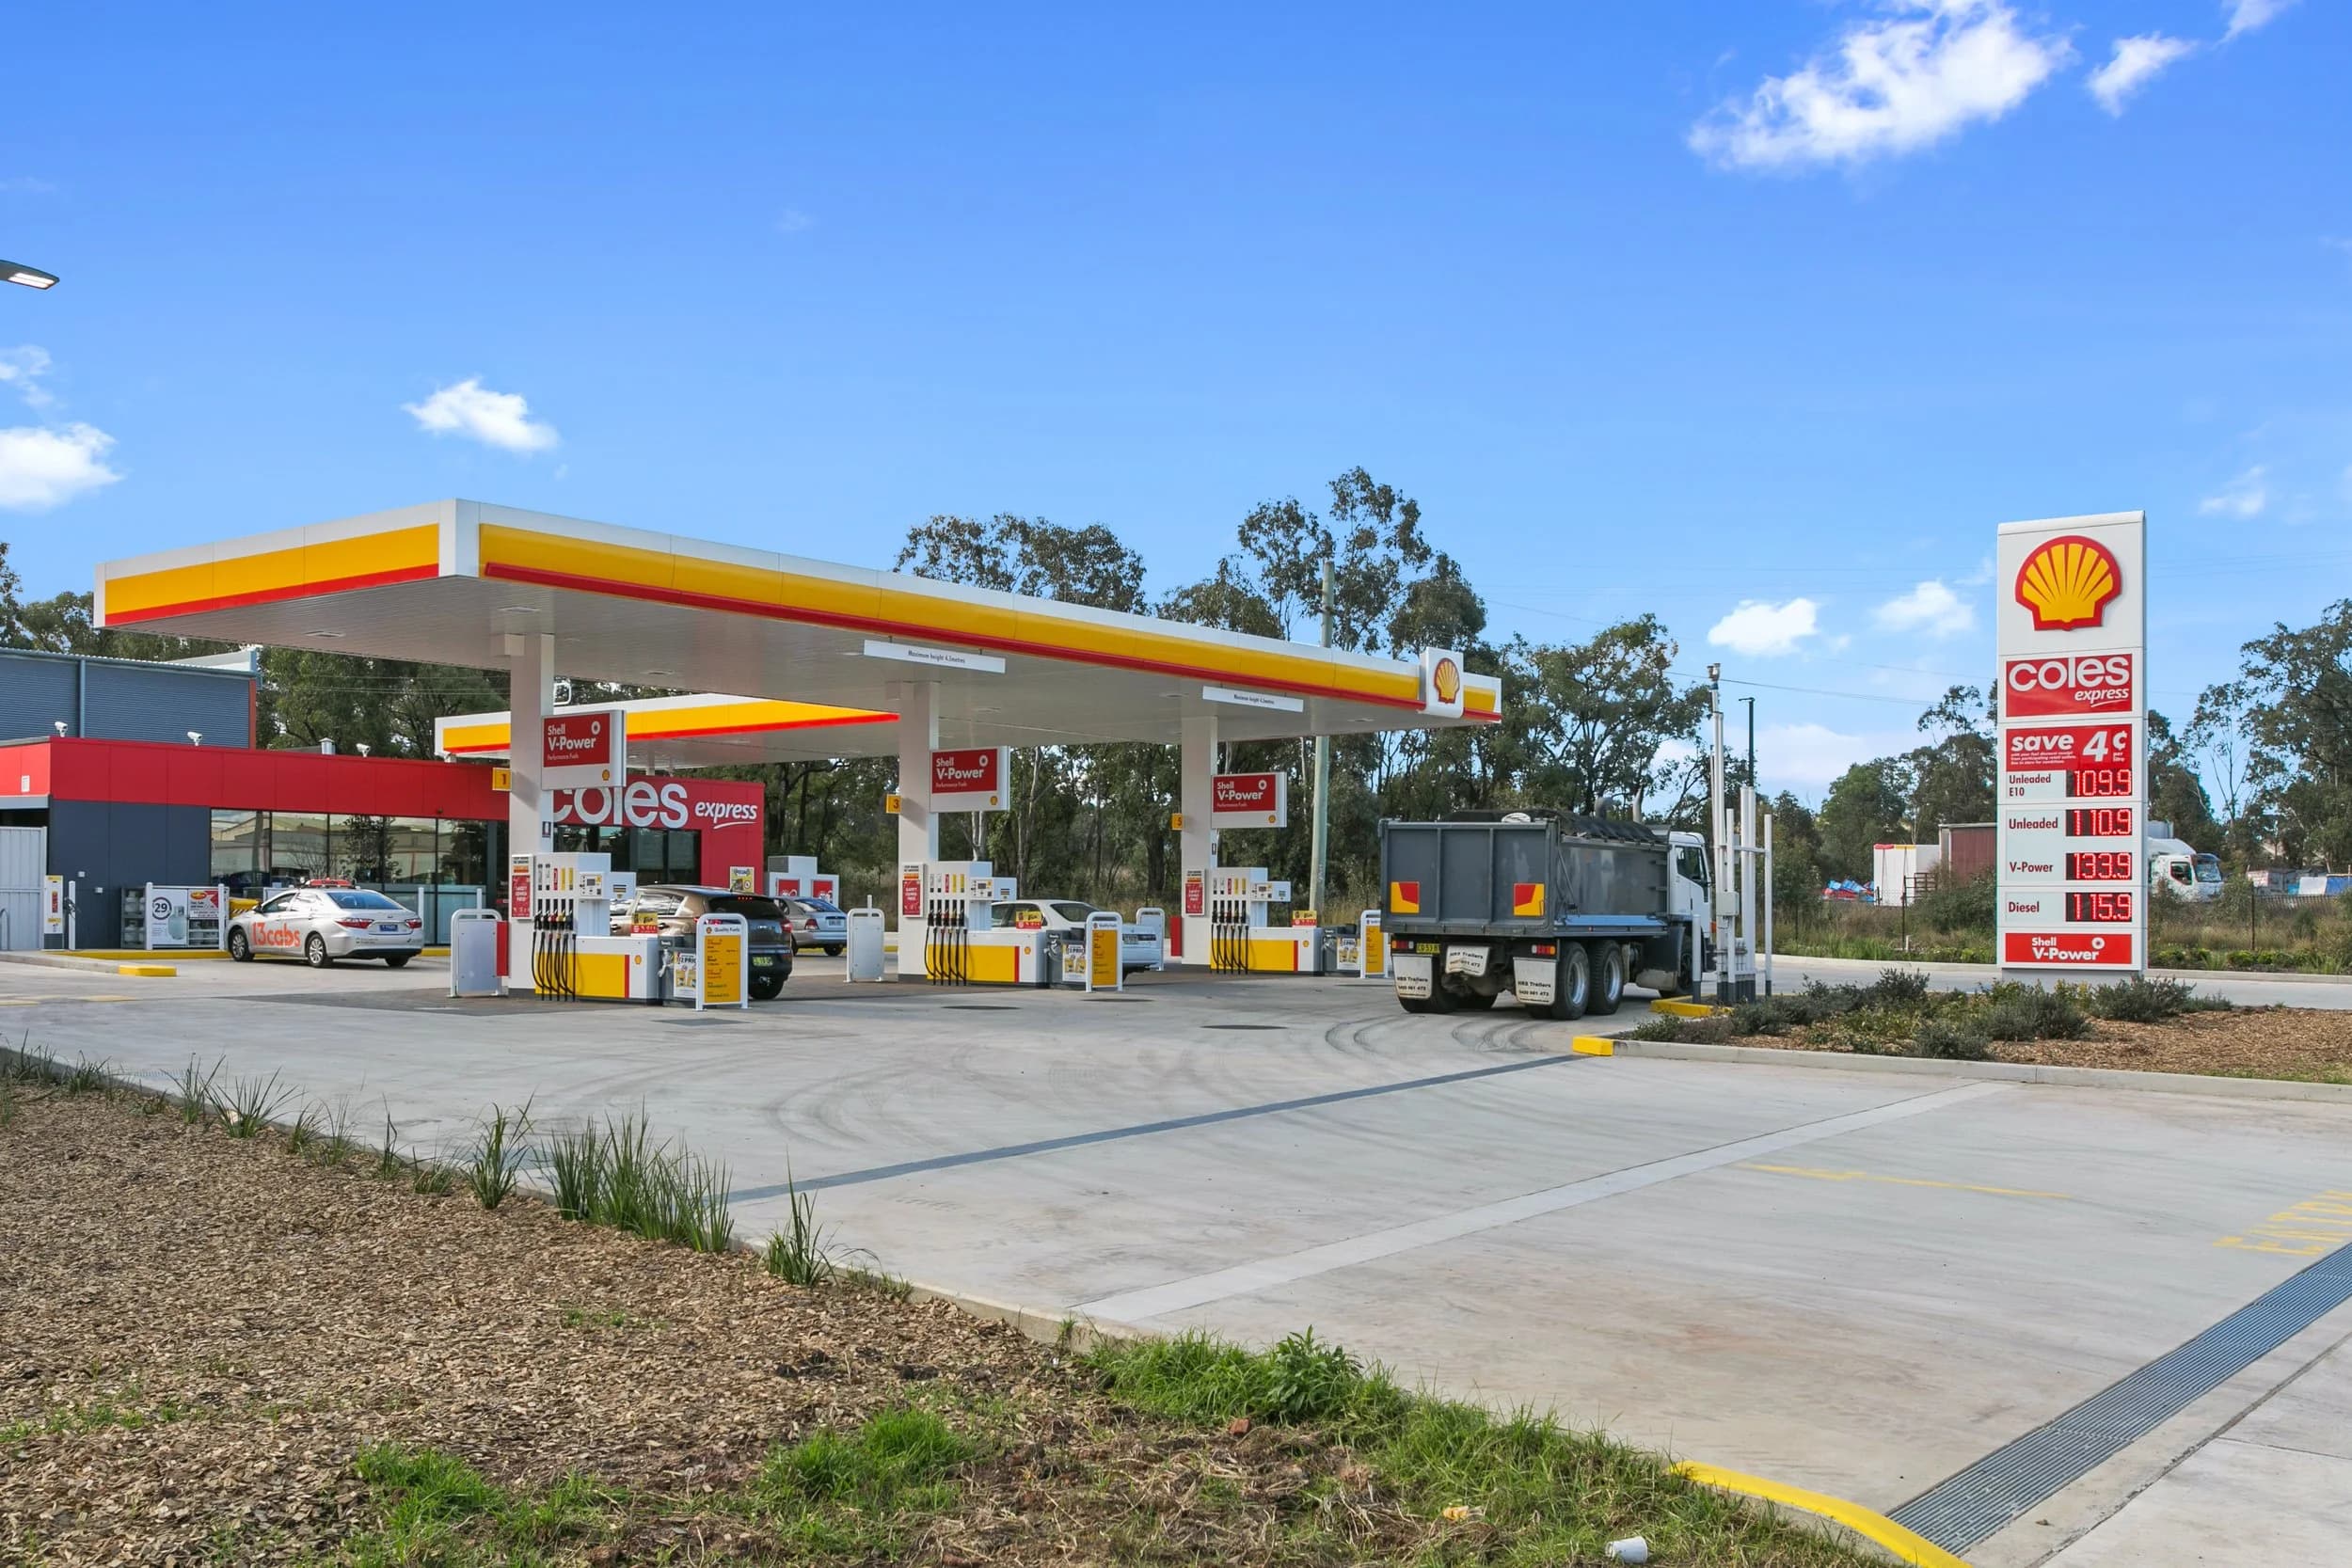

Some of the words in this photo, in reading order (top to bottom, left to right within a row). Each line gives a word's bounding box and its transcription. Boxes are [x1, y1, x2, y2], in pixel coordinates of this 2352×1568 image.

[2009, 656, 2130, 691] coles
[2074, 688, 2129, 704] express
[548, 723, 565, 735] Shell
[548, 736, 596, 751] V-Power
[2010, 735, 2074, 752] save
[936, 756, 954, 767] Shell
[936, 768, 984, 780] V-Power
[2009, 773, 2051, 784] Unleaded
[1216, 781, 1234, 790] Shell
[2074, 769, 2132, 796] 109.9
[1217, 790, 1263, 800] V-Power
[2009, 787, 2026, 797] E10
[893, 799, 900, 809] 3
[694, 800, 758, 823] express
[2009, 817, 2058, 830] Unleaded
[2074, 809, 2132, 835] 110.9
[2010, 862, 2053, 873] V-Power
[2074, 853, 2132, 879] 133.9
[154, 903, 168, 912] 29
[2009, 901, 2040, 912] Diesel
[2074, 894, 2132, 920] 115.9
[251, 922, 300, 947] 13cabs
[2031, 937, 2057, 946] Shell
[1462, 951, 1484, 959] Trailers
[2032, 947, 2100, 960] V-Power
